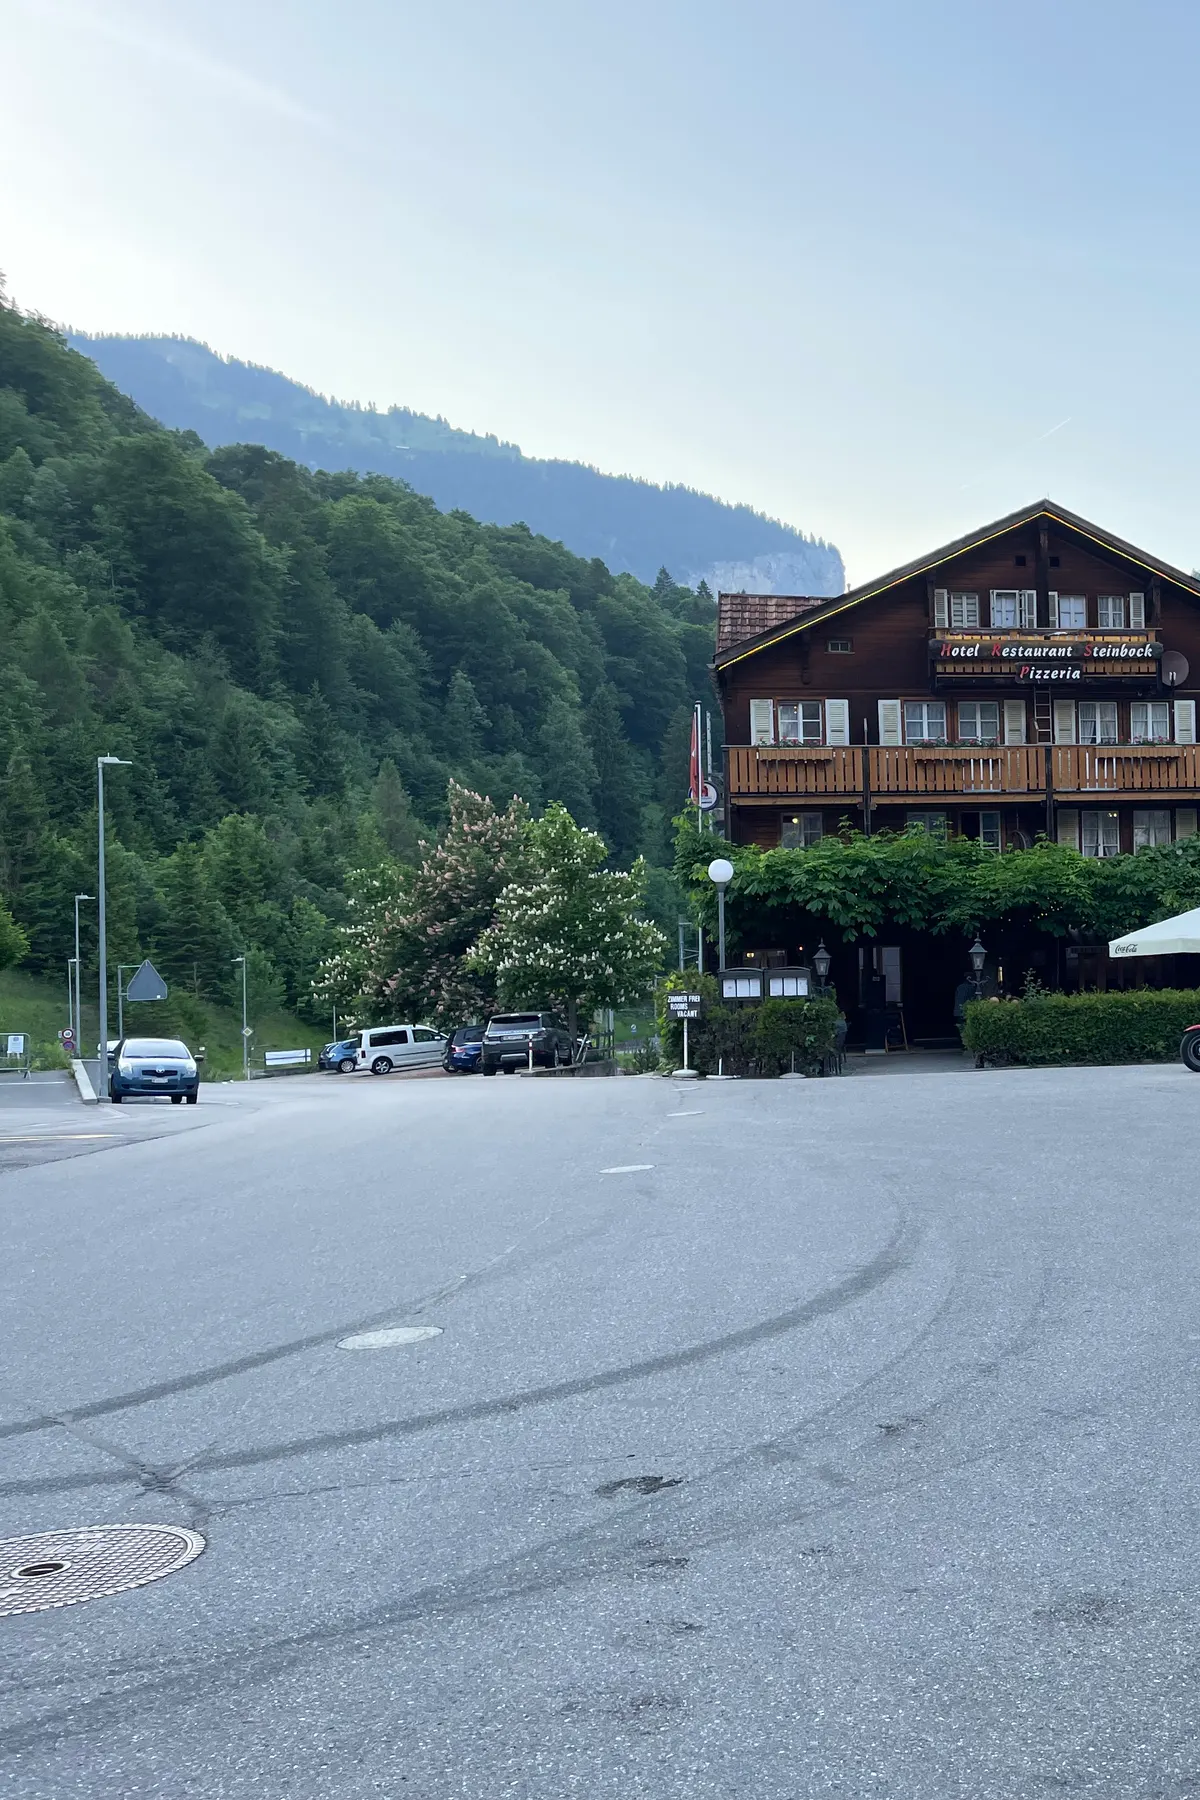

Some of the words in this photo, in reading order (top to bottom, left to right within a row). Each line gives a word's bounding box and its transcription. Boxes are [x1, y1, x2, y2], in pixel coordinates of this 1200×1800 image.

[941, 643, 980, 657] Hotel
[991, 643, 1073, 657] Restaurant
[1084, 643, 1152, 657] Steinbock
[1019, 665, 1081, 680] Pizzeria
